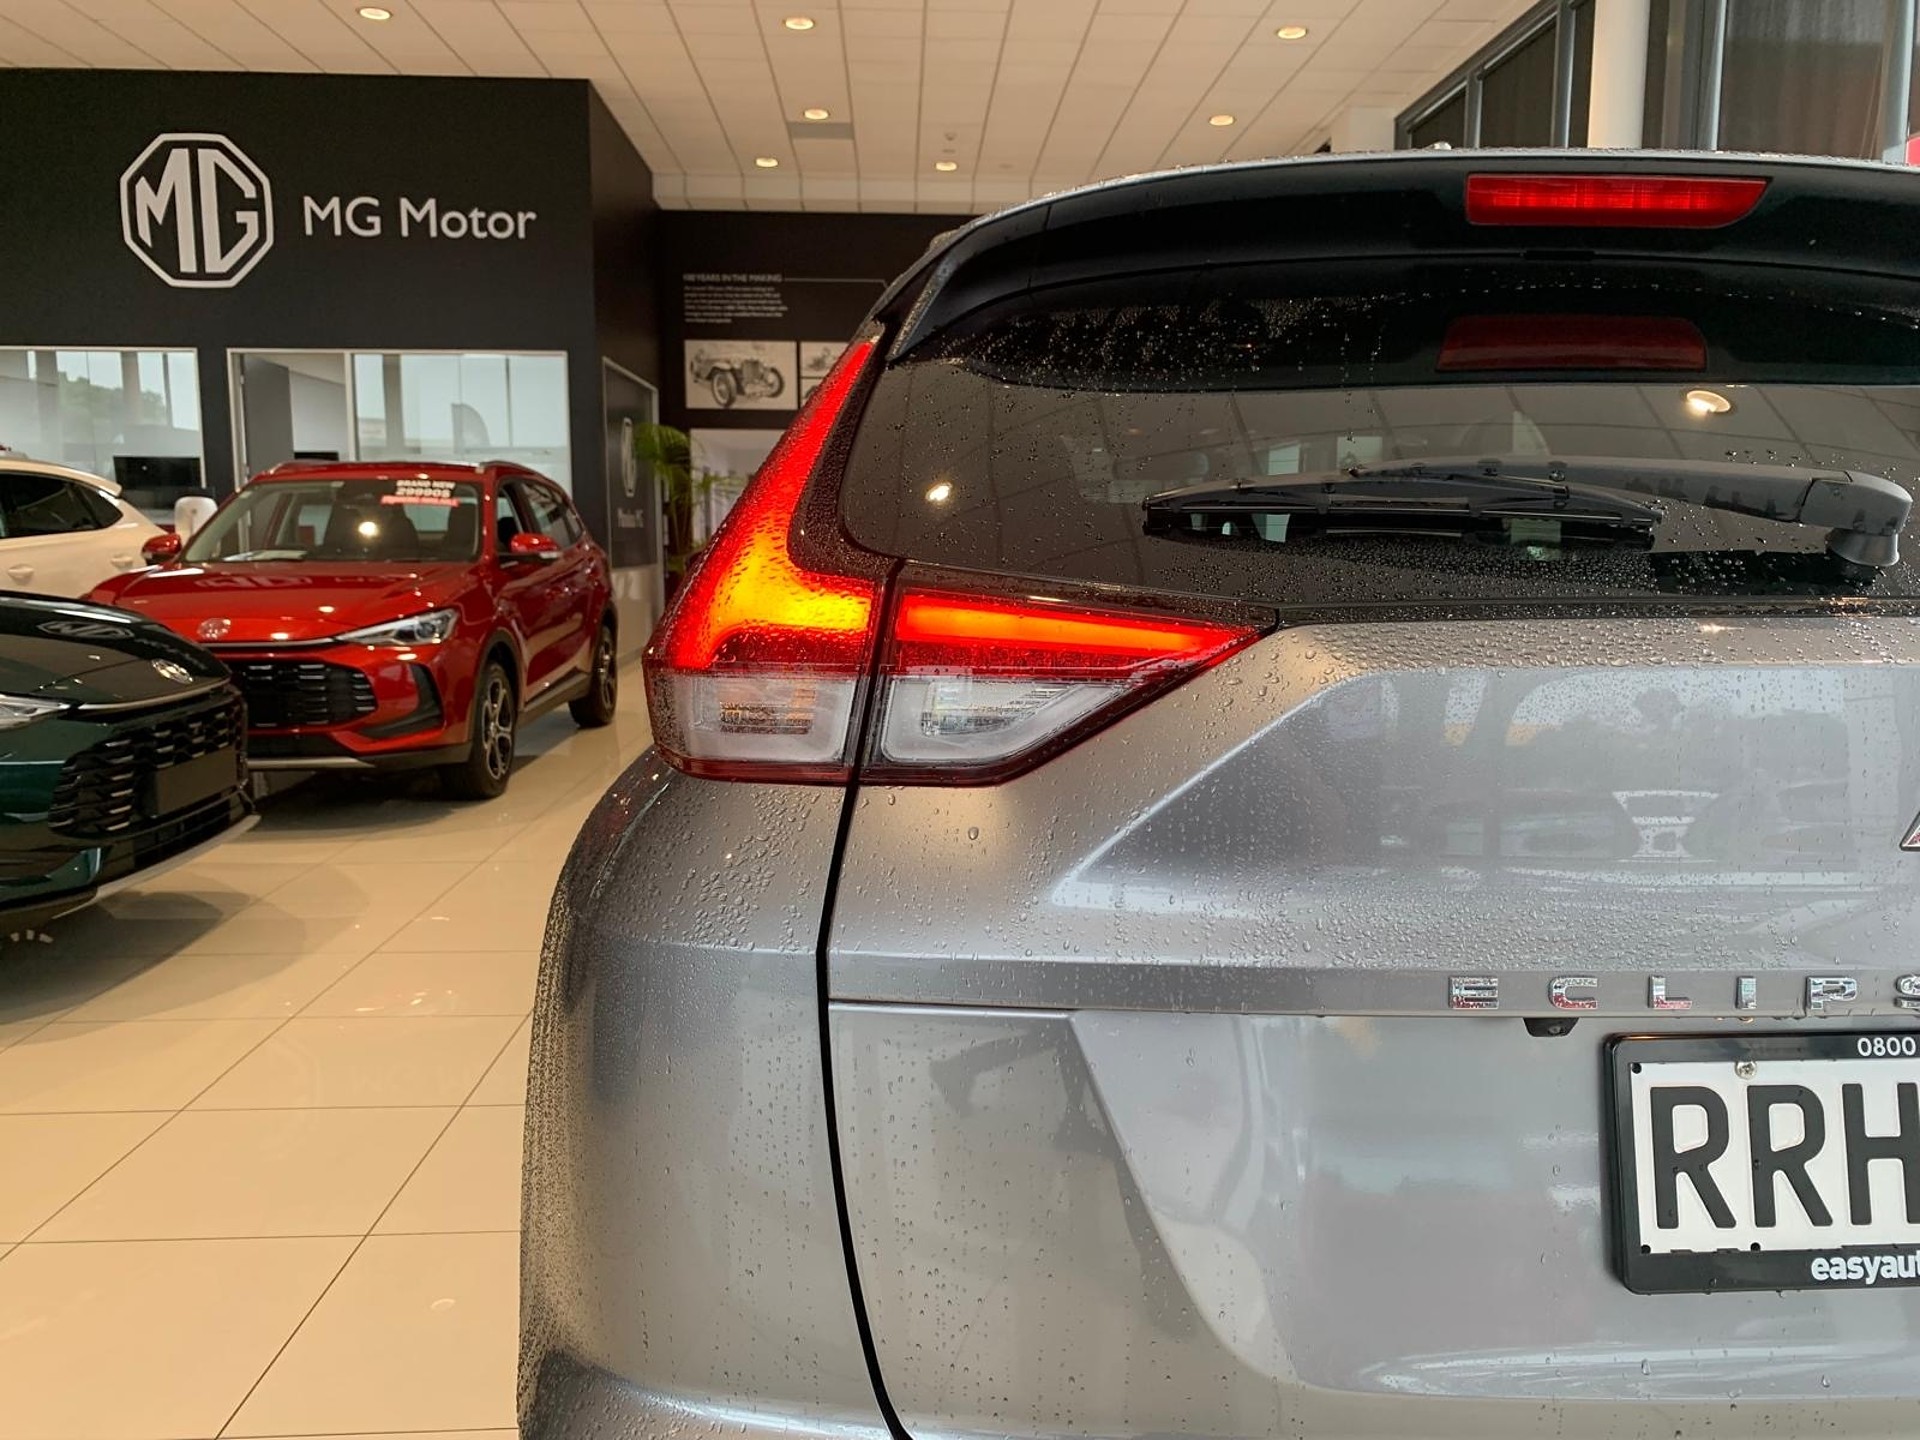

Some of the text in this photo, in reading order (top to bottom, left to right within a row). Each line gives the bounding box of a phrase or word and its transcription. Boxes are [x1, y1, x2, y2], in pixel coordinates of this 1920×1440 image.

[135, 148, 260, 273] MG
[304, 196, 537, 239] MG Motor
[1857, 1036, 1917, 1057] 0800
[1650, 1083, 1920, 1229] RRH
